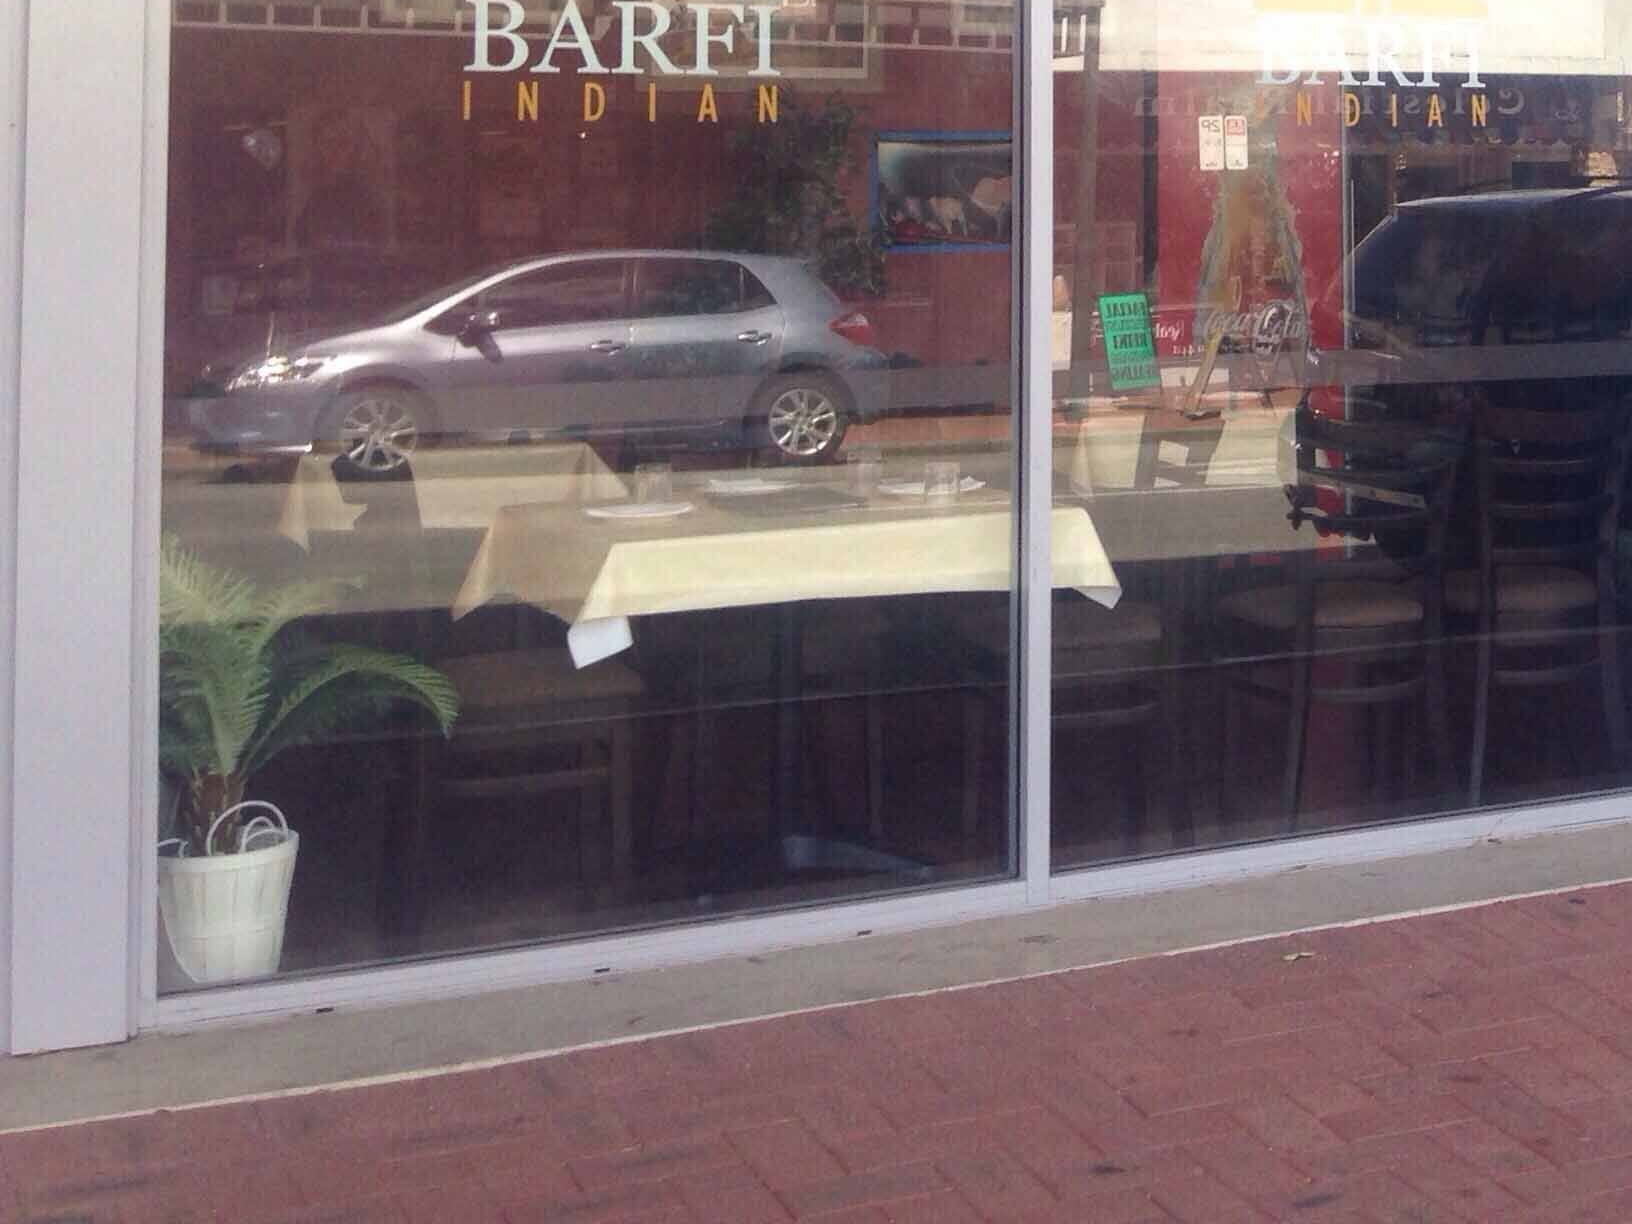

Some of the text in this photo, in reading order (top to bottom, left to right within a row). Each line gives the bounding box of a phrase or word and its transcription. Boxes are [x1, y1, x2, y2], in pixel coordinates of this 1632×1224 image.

[1254, 18, 1487, 88] BARFI
[463, 80, 778, 123] INDIAN
[1256, 92, 1488, 127] INDIAN
